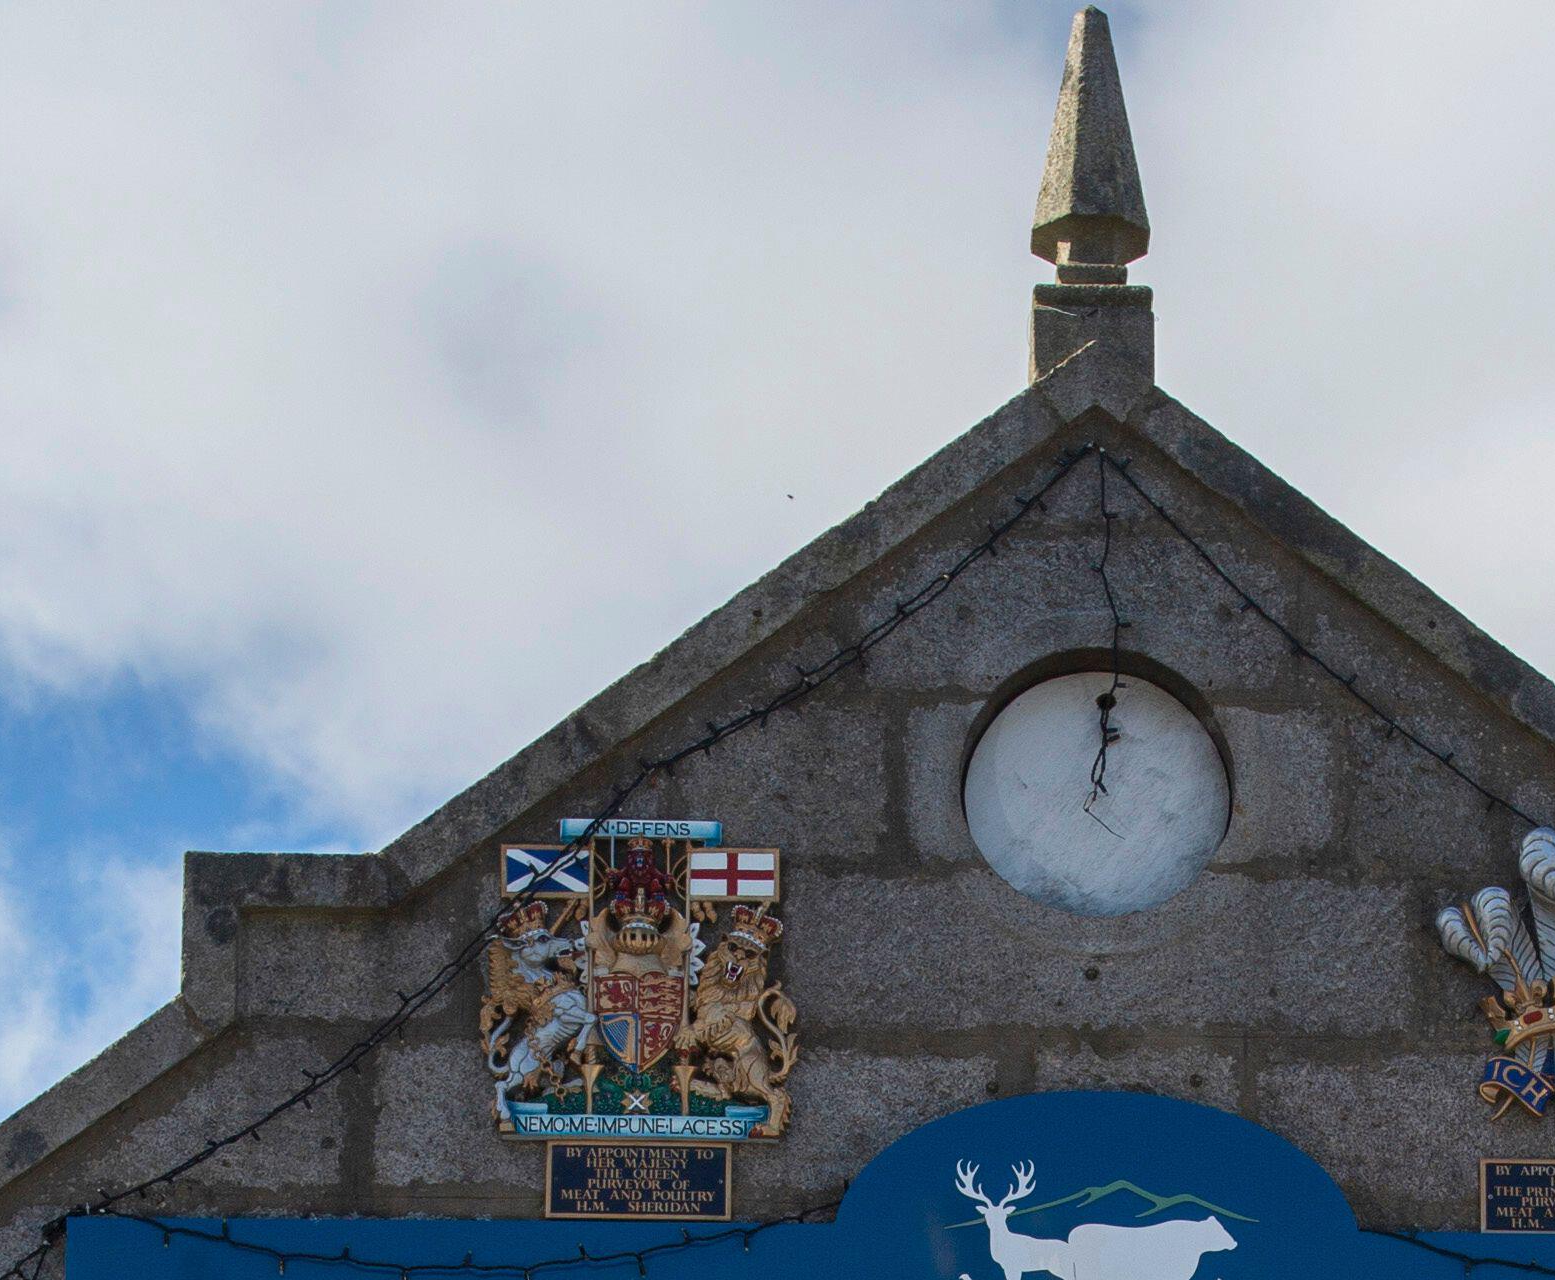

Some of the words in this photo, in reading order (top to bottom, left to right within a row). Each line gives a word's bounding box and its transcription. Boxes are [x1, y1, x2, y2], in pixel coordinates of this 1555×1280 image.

[1491, 1061, 1549, 1107] ICH
[566, 1147, 583, 1158] BY
[587, 1147, 690, 1159] APPOINTMENT
[697, 1149, 714, 1160] TO
[587, 1158, 615, 1168] HER
[625, 1158, 689, 1169] MAJESTY
[596, 1169, 622, 1179] THE
[633, 1169, 679, 1180] QUEEN
[1496, 1166, 1512, 1176] BY
[588, 1179, 660, 1190] PURVEYOR
[672, 1180, 690, 1190] OF
[561, 1189, 599, 1200] MEAT
[610, 1190, 642, 1200] AND
[652, 1190, 715, 1202] POULTRY
[1495, 1186, 1521, 1197] THE
[576, 1200, 609, 1212] H.M.
[628, 1201, 700, 1213] SHERIDAN
[1496, 1207, 1534, 1218] MEAT
[1511, 1218, 1544, 1229] H.M.
